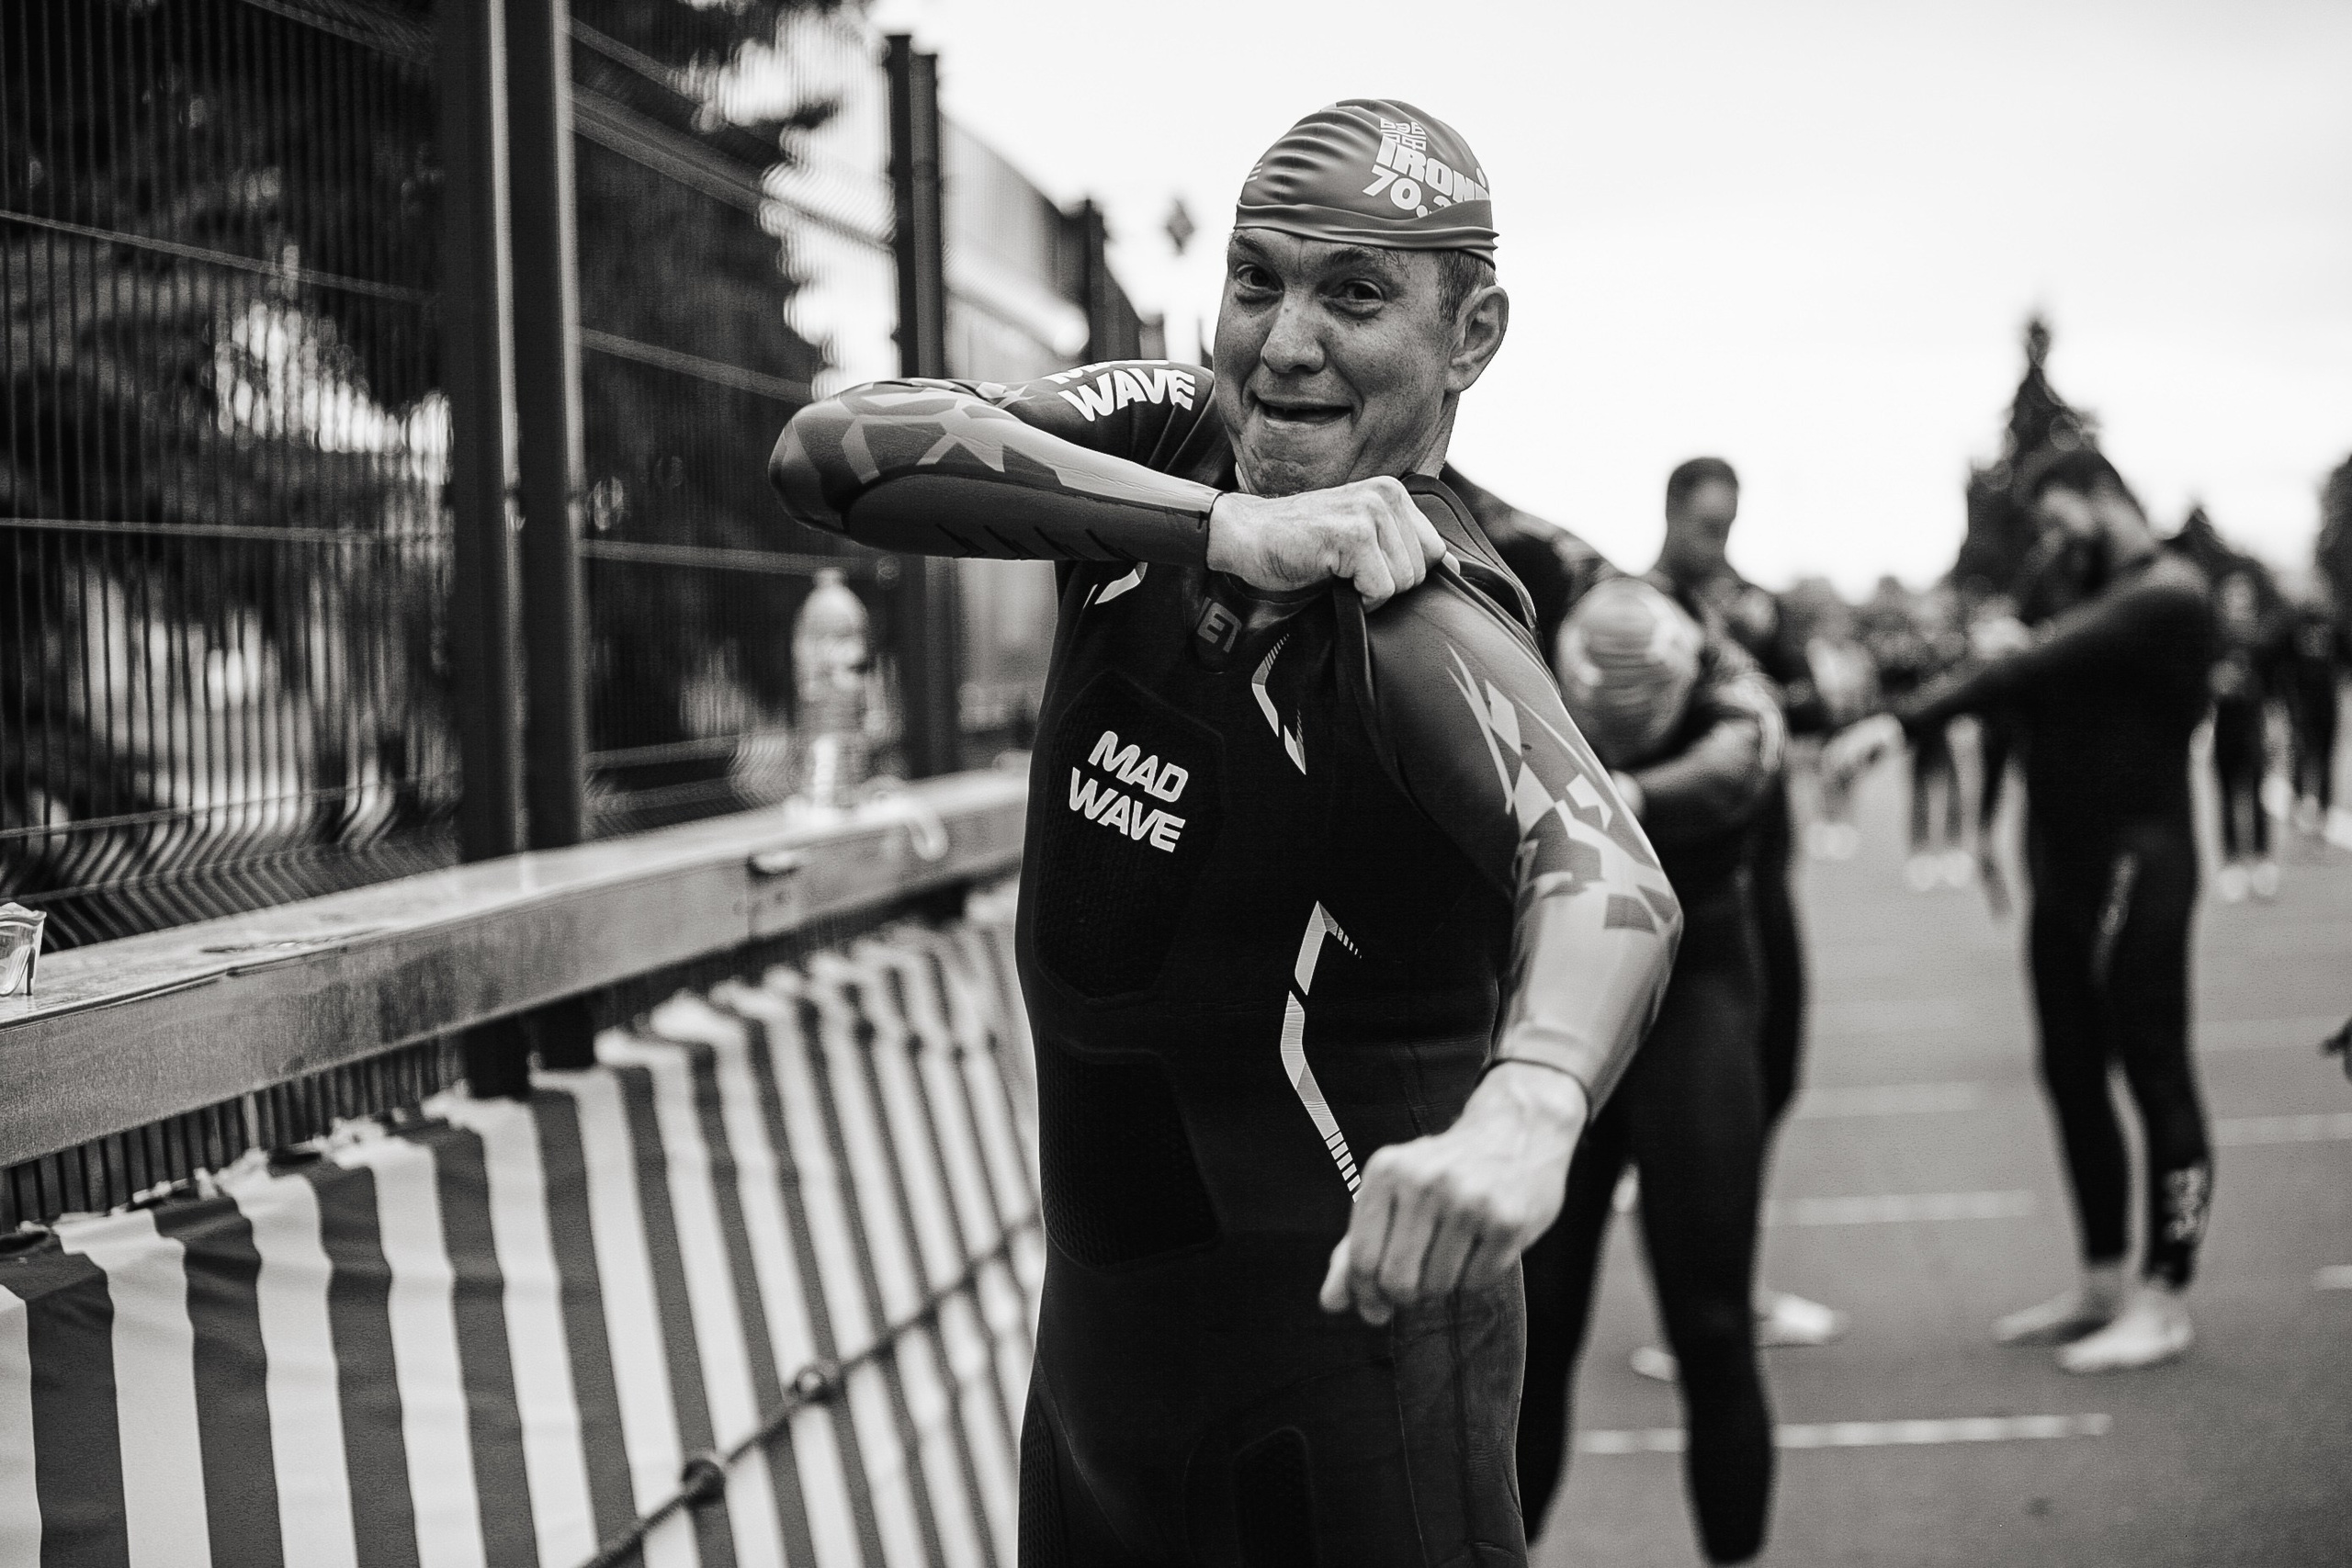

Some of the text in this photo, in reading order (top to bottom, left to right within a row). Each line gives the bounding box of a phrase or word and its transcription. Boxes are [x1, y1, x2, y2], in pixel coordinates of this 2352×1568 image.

[1057, 368, 1195, 422] WAVE
[1087, 730, 1189, 803] MAD
[1069, 766, 1186, 853] WAVE
